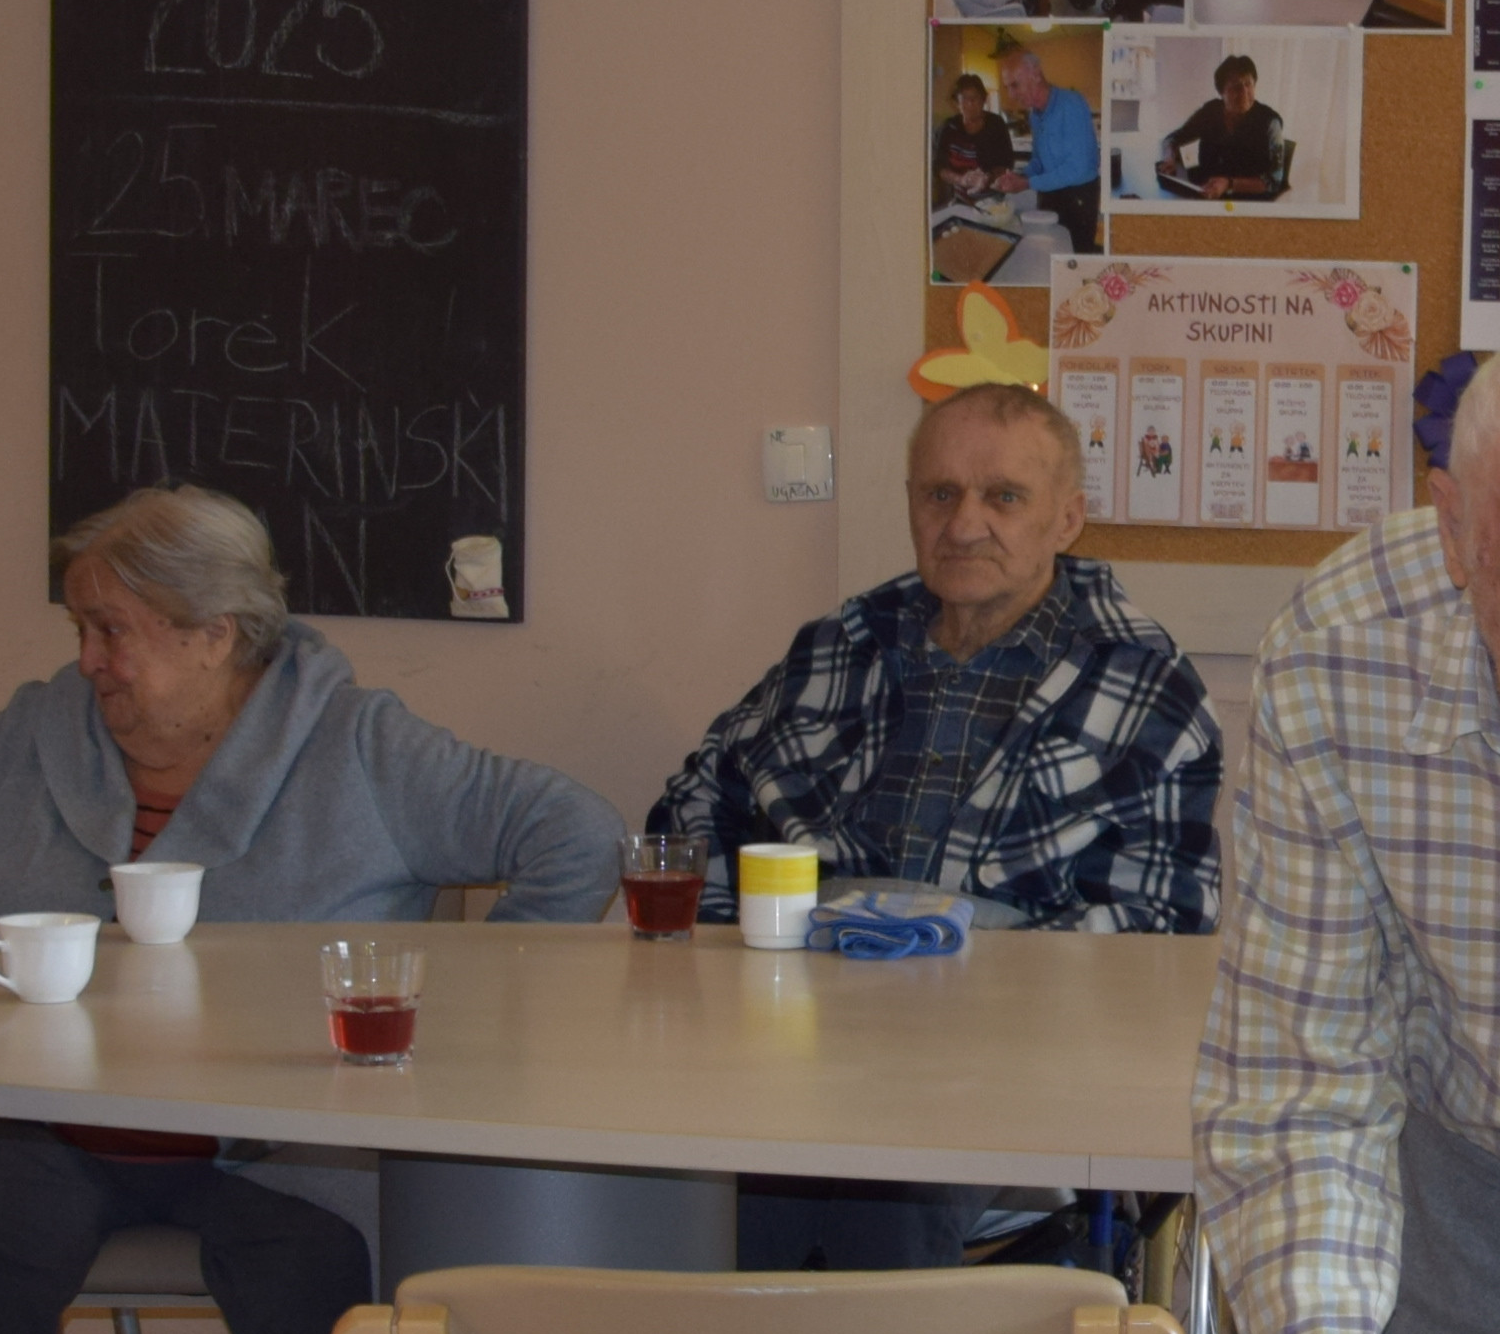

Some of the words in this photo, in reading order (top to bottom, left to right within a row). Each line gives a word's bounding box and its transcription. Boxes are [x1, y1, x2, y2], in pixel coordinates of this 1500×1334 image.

[1148, 292, 1277, 315] AKTIVNOSTI
[1286, 296, 1313, 315] NA
[1186, 322, 1272, 343] SKUPINI
[57, 383, 509, 523] MATERINSKI
